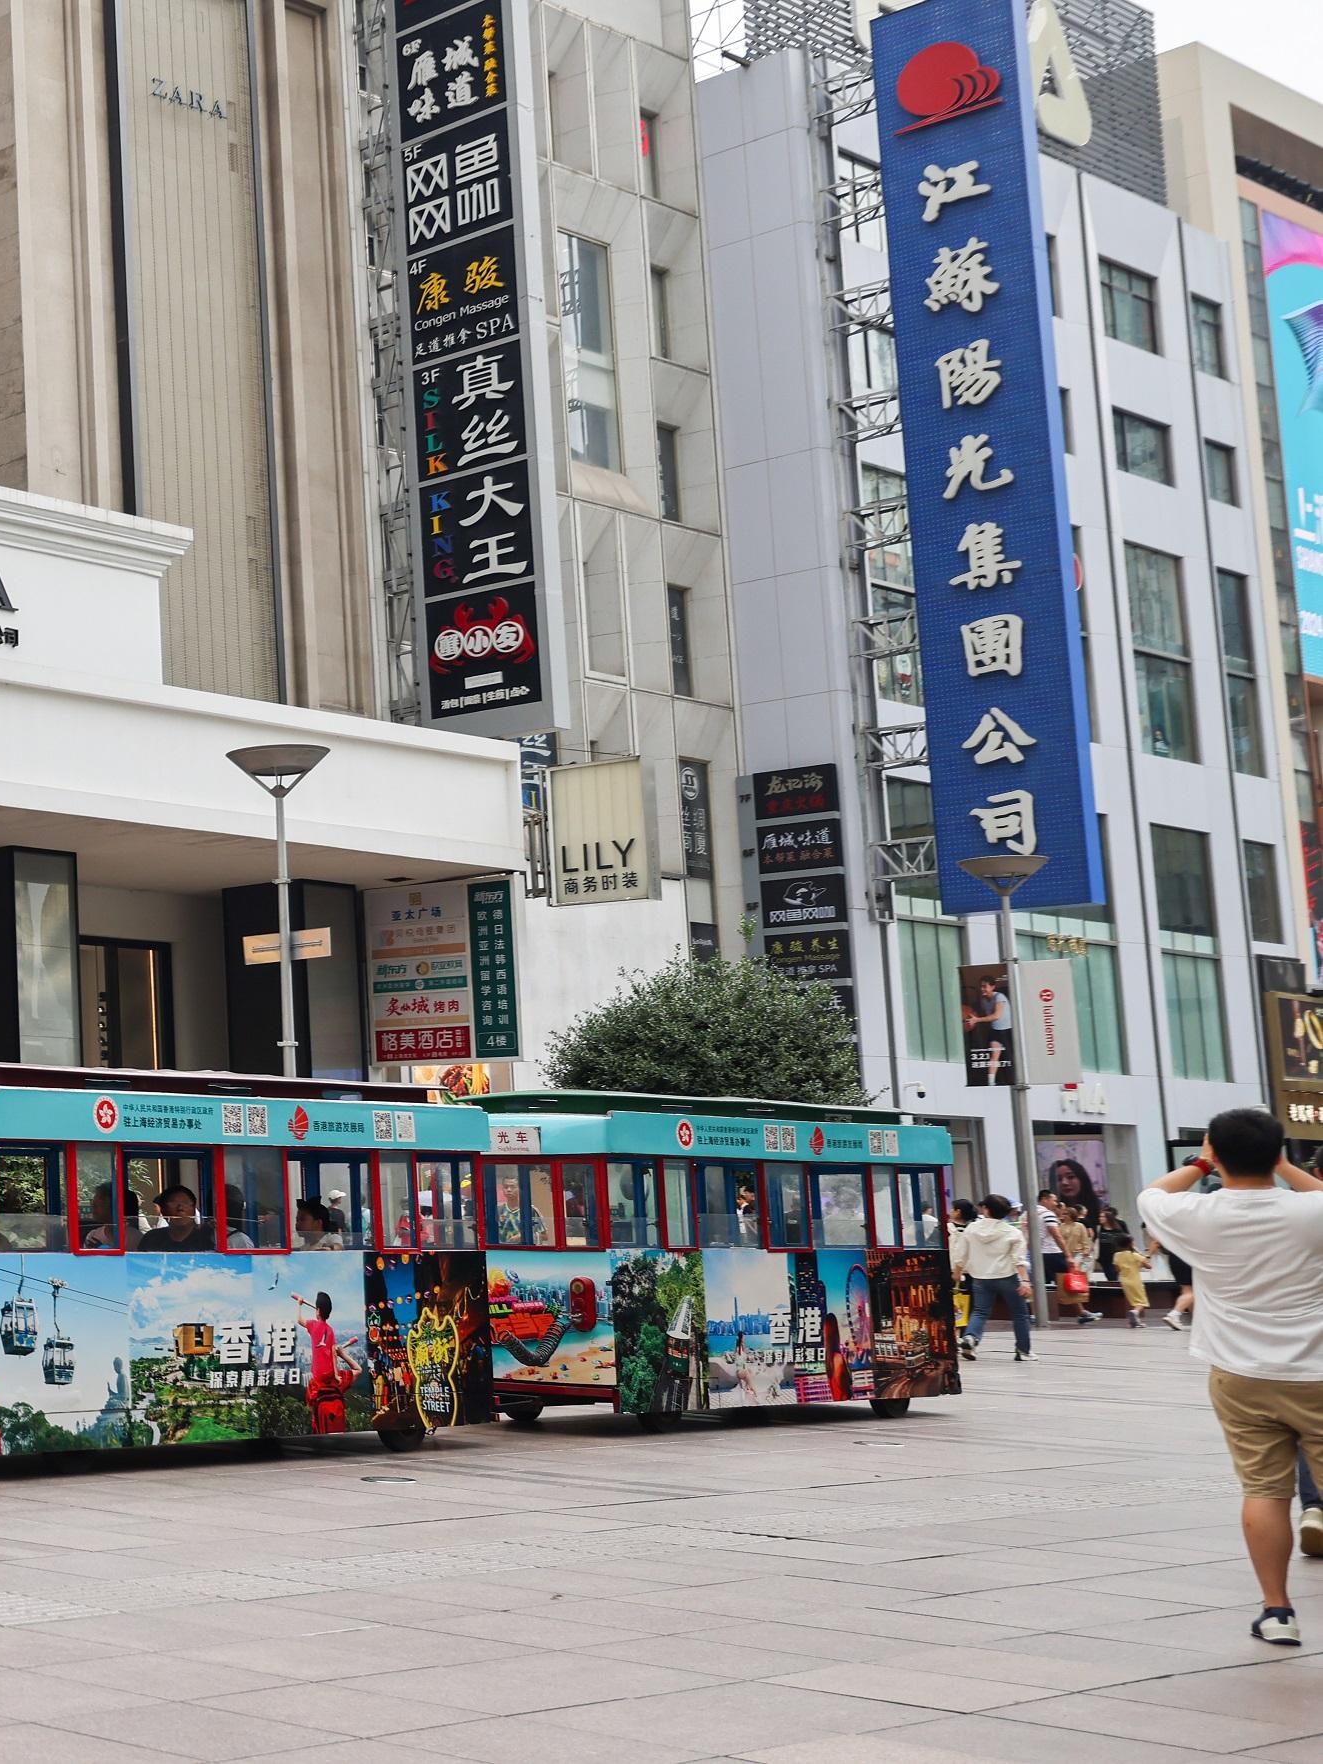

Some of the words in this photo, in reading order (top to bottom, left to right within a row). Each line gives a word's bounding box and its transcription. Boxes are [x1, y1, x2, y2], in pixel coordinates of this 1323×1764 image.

[402, 38, 422, 56] 6F
[150, 78, 227, 120] ZARA
[404, 144, 422, 163] 5F
[409, 258, 427, 276] 4F
[416, 255, 506, 315] 康骏
[414, 310, 456, 332] Congen
[459, 293, 510, 317] Massage
[475, 313, 516, 340] SPA
[421, 367, 440, 386] 3F
[421, 387, 449, 476] SILK
[451, 353, 528, 585] 真丝大王
[914, 158, 1039, 858] 江蘇陽光集團公司
[429, 491, 456, 580] KING
[761, 827, 834, 850] 雁城味道
[561, 838, 635, 873] LILY
[563, 872, 639, 896] 商务时装
[390, 906, 443, 921] 亚太广场
[769, 906, 837, 923] 网鱼网咖
[818, 963, 838, 974] SPA
[381, 1029, 454, 1051] 格美酒店
[486, 1034, 507, 1047] 4楼
[1042, 1005, 1056, 1056] lululemon
[123, 1116, 203, 1130] 驻上海经济贸易办事处
[312, 1120, 365, 1134] 香港旅游发展局
[497, 1131, 528, 1144] 光车
[769, 1306, 822, 1345] 香港
[218, 1320, 297, 1365] 香港
[763, 1347, 826, 1364] 探索精彩夏日
[209, 1366, 301, 1390] 探索精彩夏日
[422, 1400, 451, 1413] STREET
